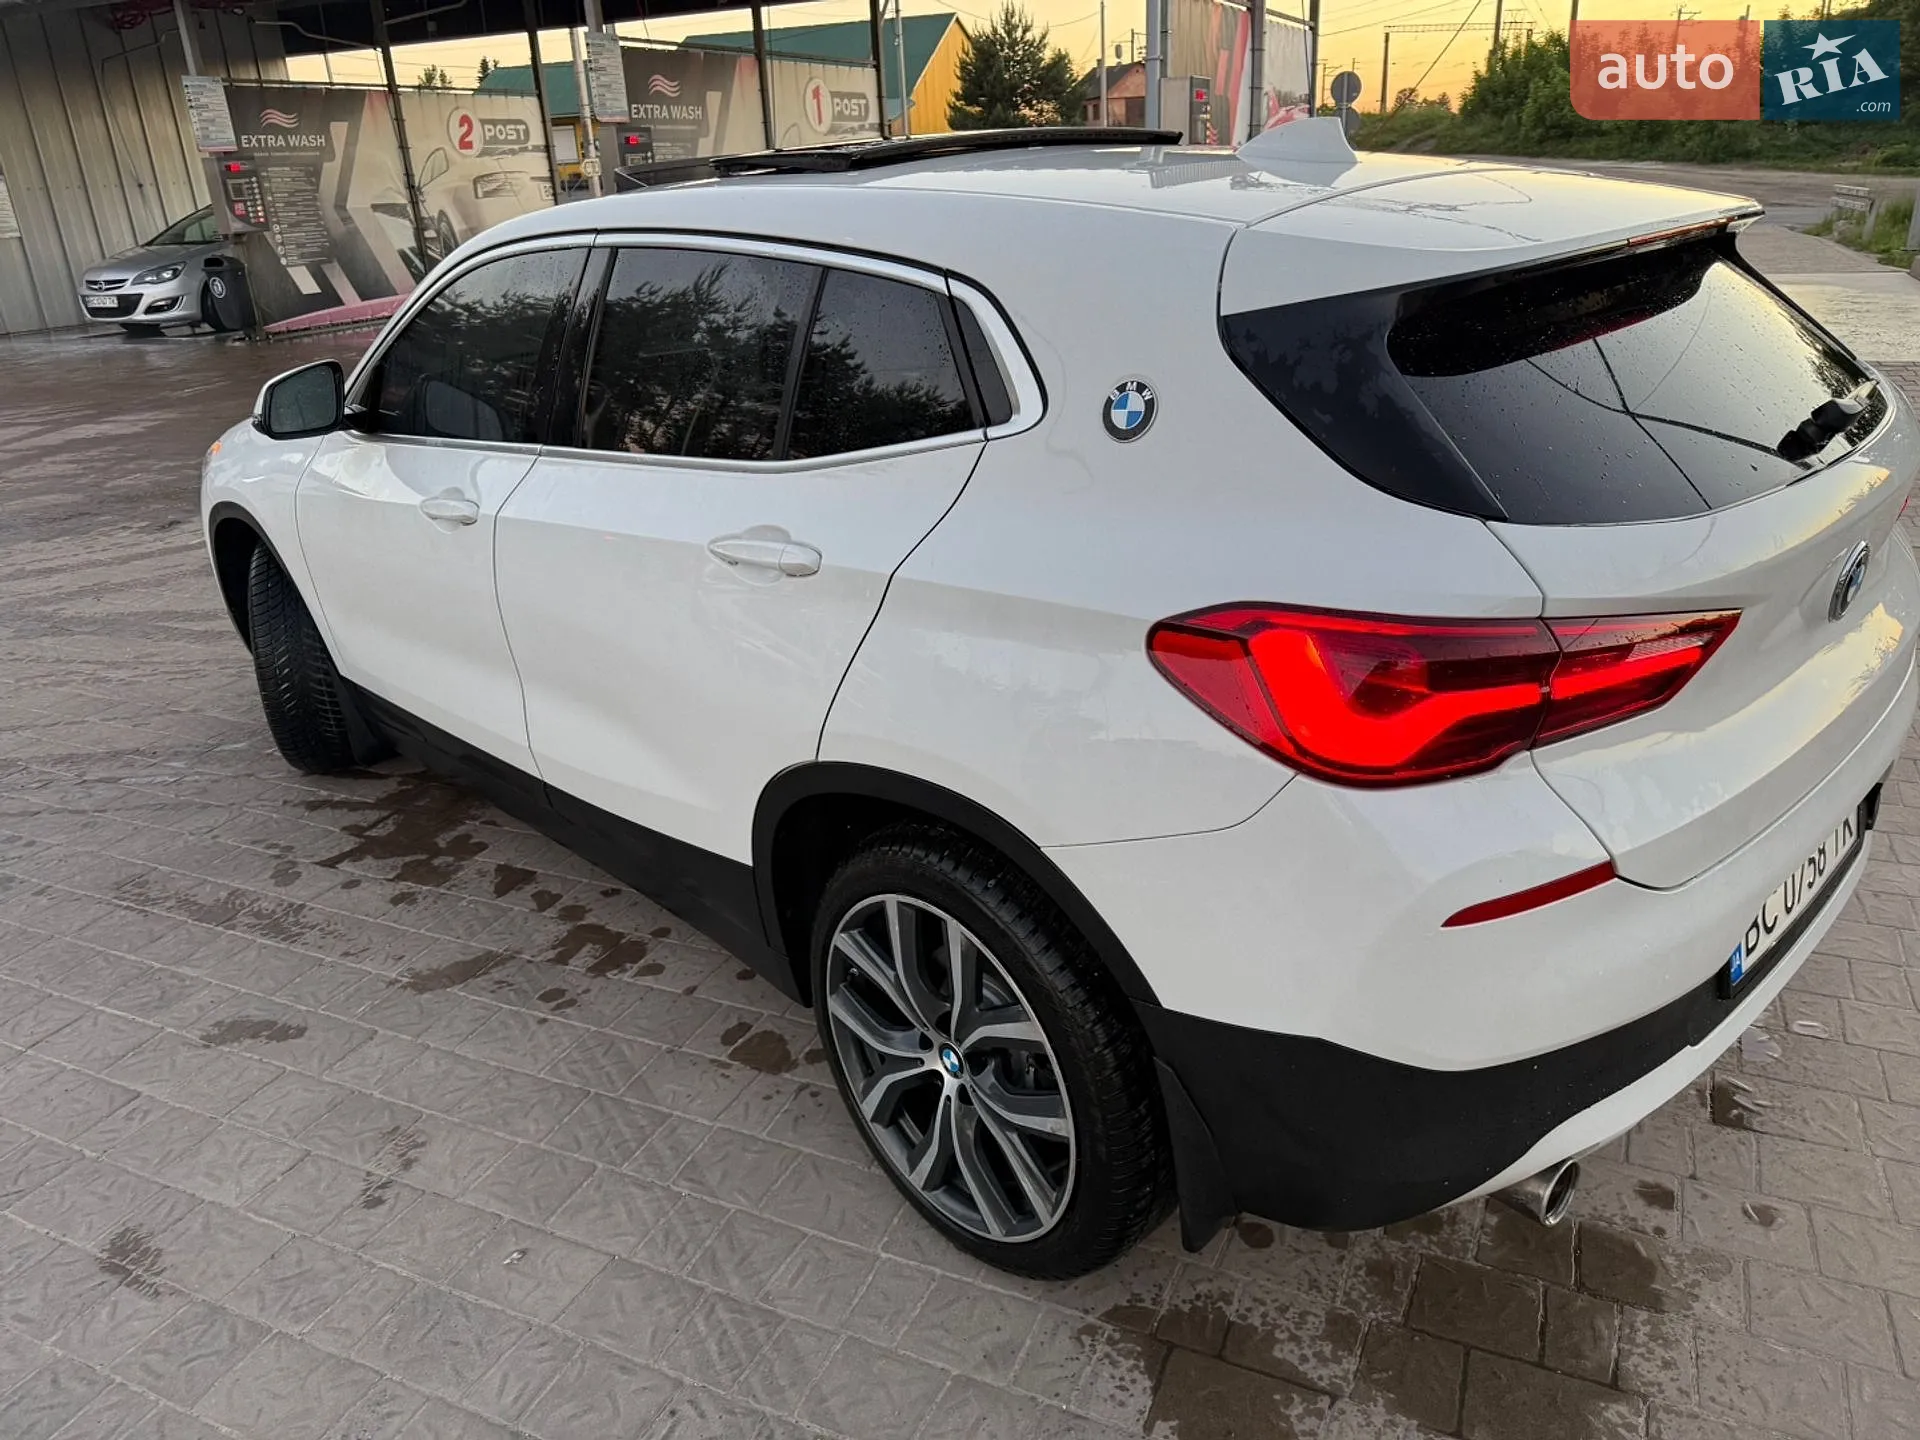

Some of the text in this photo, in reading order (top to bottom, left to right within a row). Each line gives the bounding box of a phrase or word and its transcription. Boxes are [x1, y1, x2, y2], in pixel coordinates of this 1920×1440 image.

[631, 104, 703, 119] EXTRA WASH
[812, 85, 867, 127] 1 POST
[241, 134, 326, 148] EXTRA WASH
[458, 113, 526, 150] 2 POST
[1110, 381, 1153, 400] BMW
